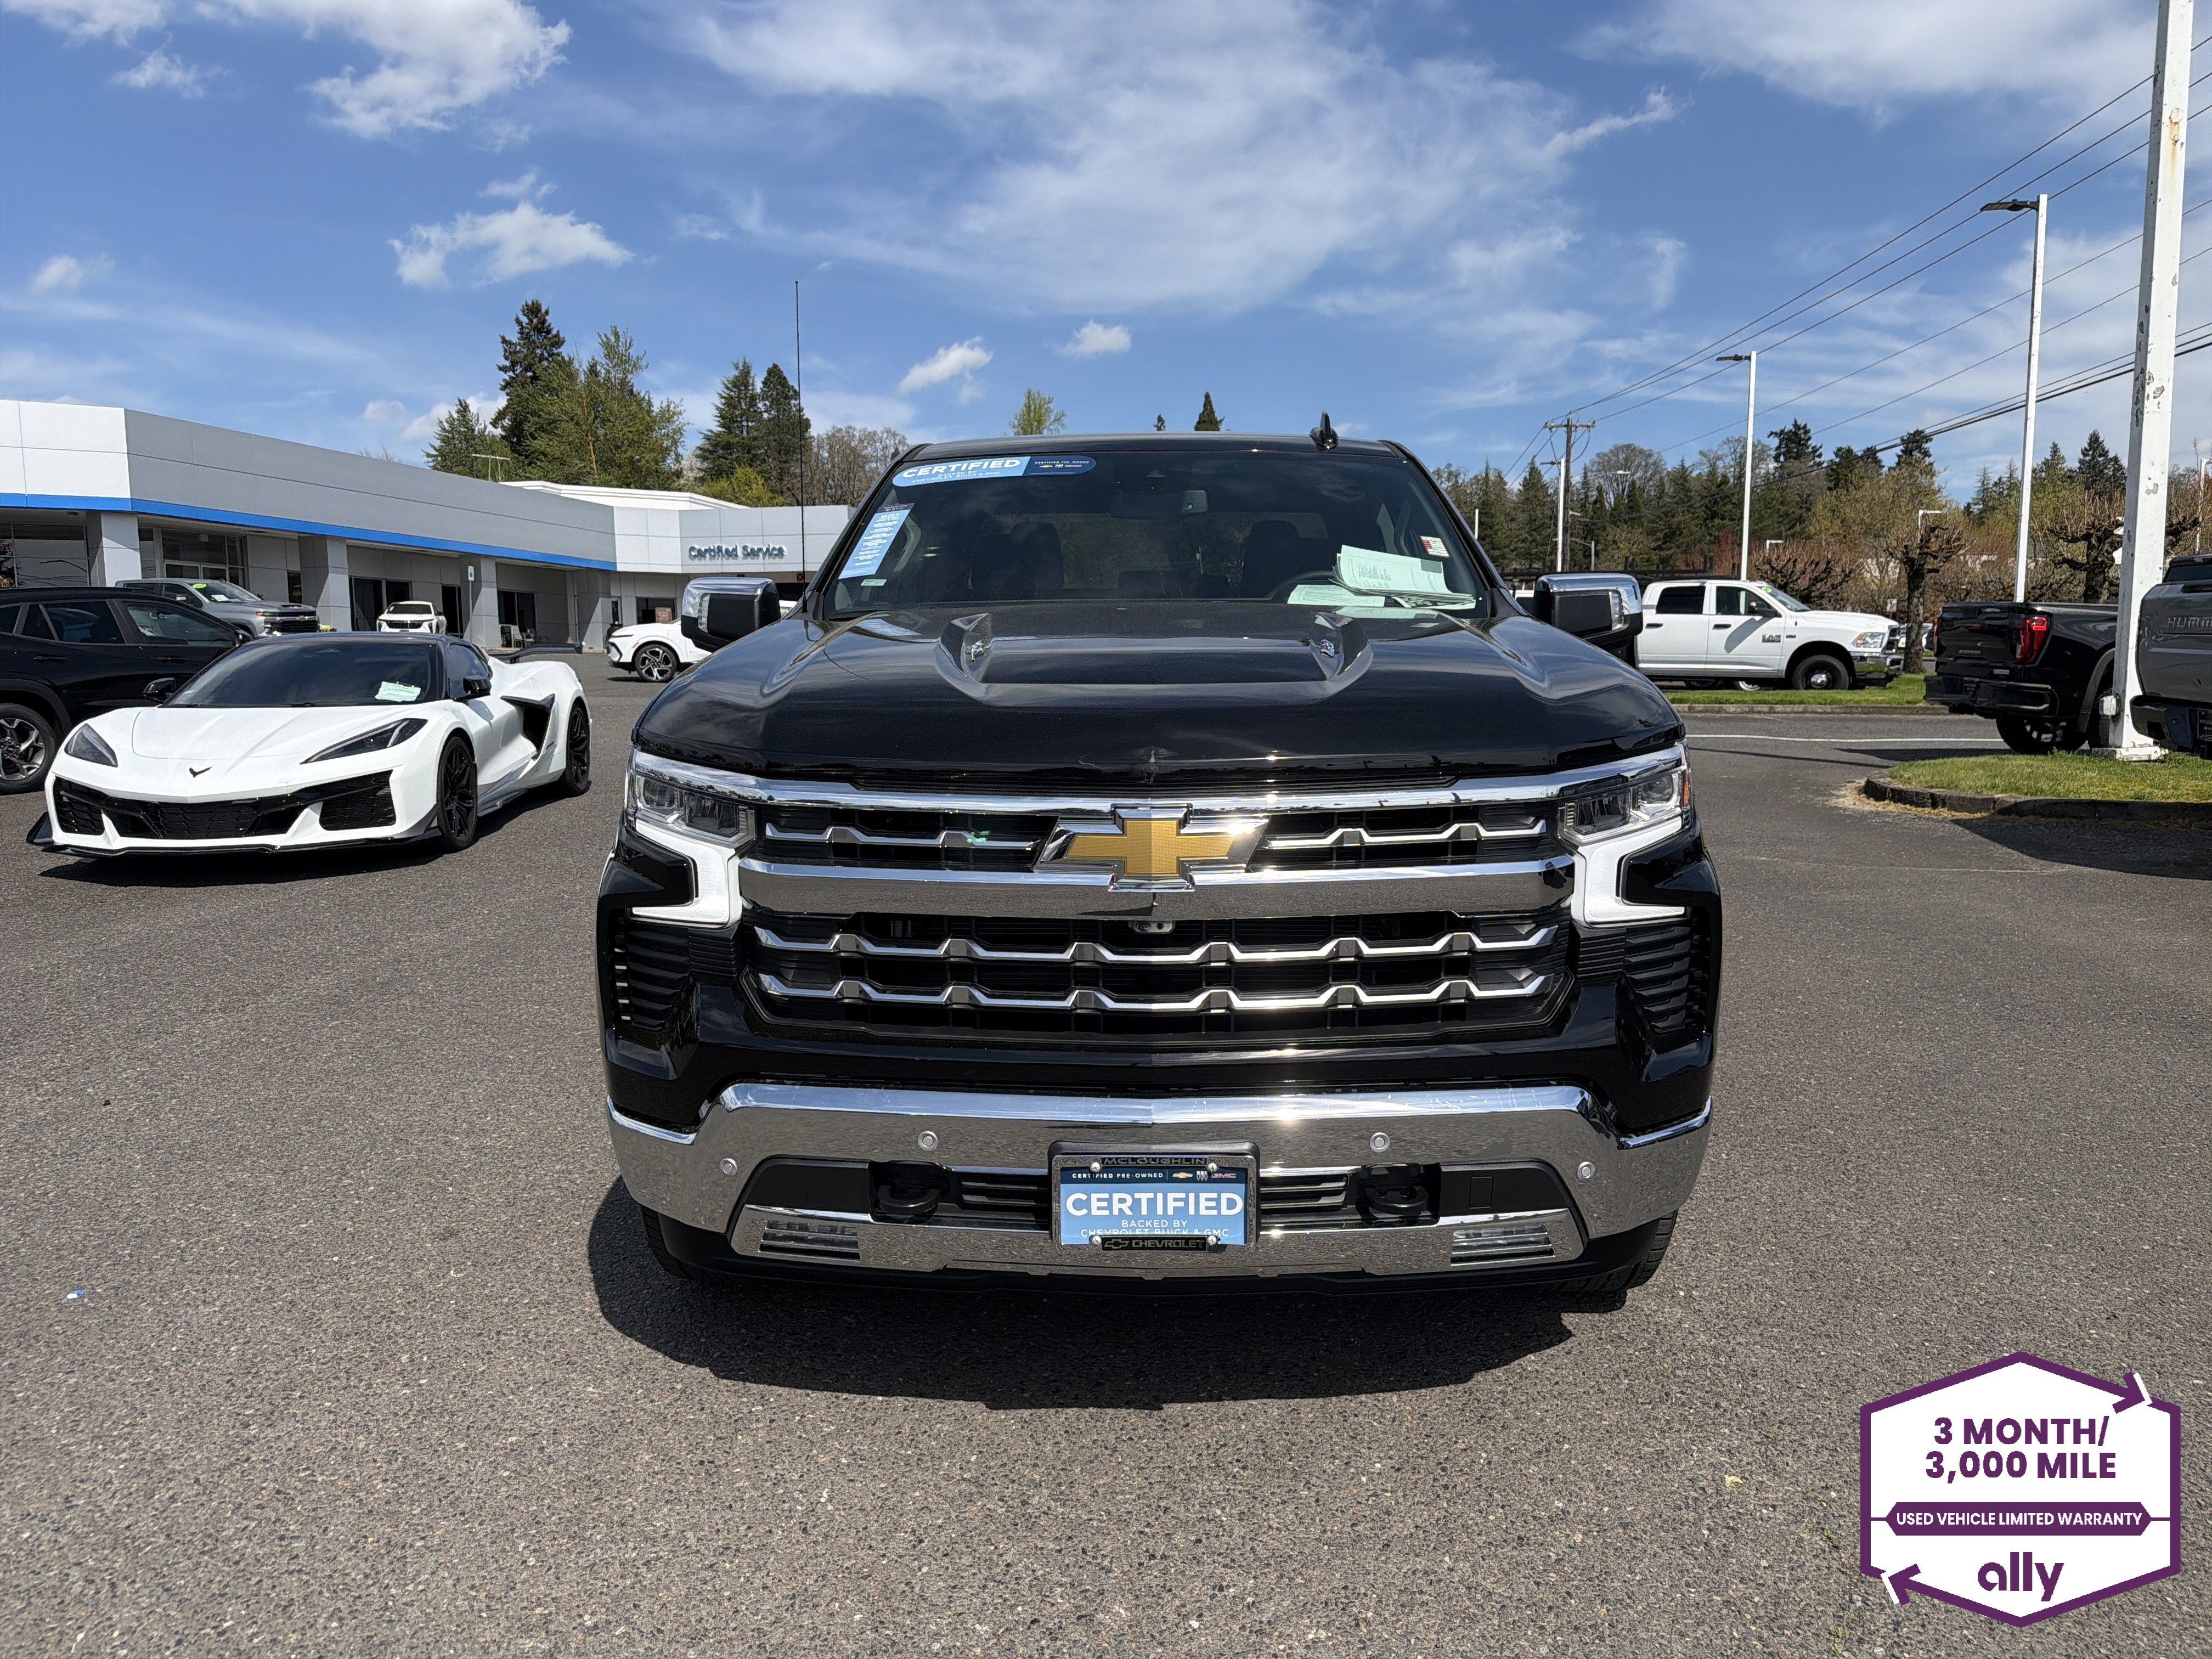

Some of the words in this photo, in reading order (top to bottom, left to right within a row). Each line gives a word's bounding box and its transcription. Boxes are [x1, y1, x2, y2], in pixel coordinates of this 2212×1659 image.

[902, 460, 1020, 477] CERTIFIED
[689, 544, 738, 557] Certified
[742, 544, 785, 556] Service
[1066, 1193, 1243, 1216] CERTIFIED
[1121, 1220, 1169, 1228] BACKED
[1173, 1220, 1188, 1228] BY
[1204, 1228, 1229, 1237] GMC
[1132, 1239, 1205, 1248] CHEVROLET
